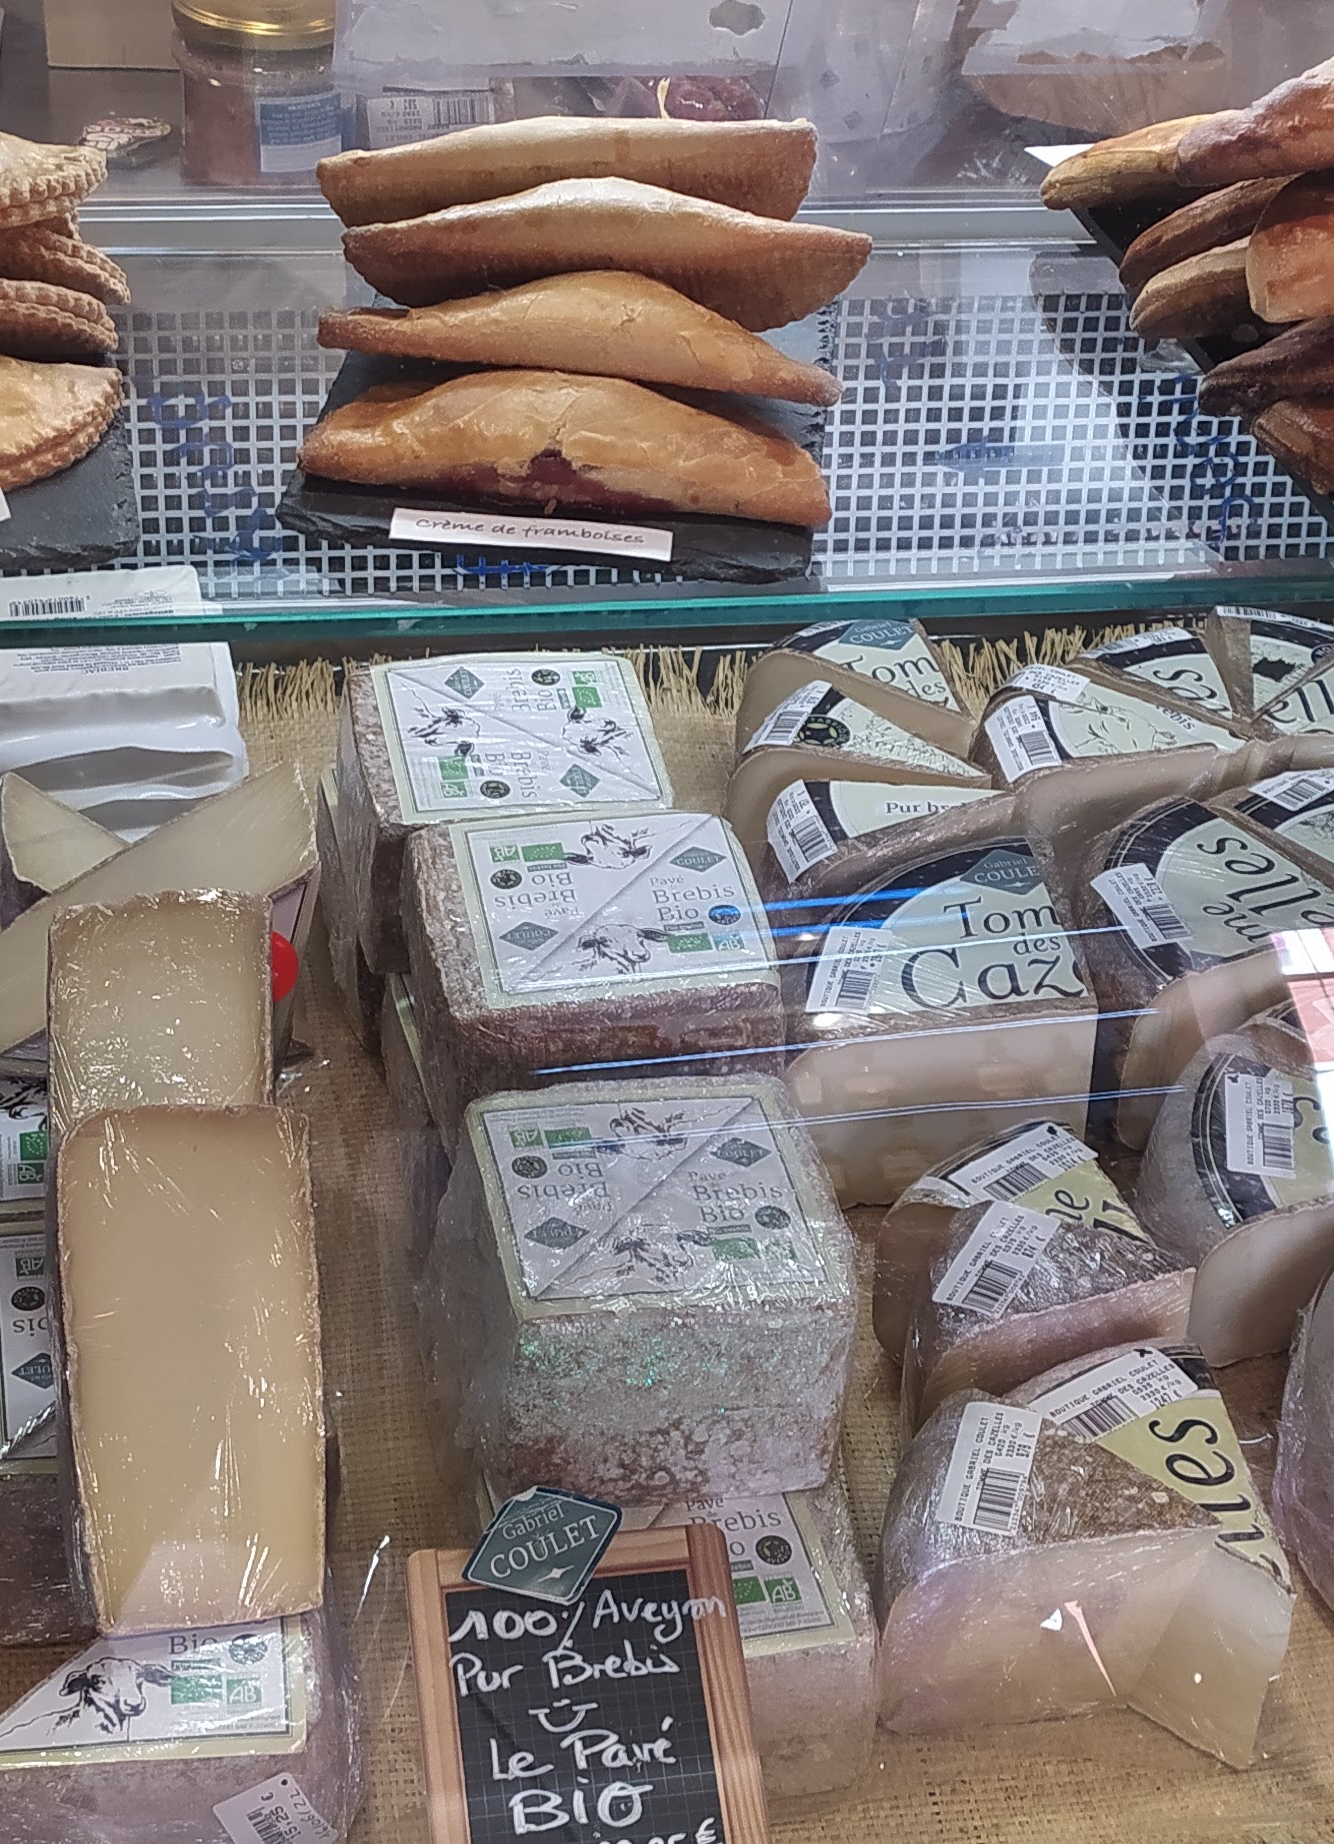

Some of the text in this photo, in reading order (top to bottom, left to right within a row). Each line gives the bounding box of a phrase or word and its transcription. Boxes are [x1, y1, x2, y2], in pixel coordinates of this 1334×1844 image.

[416, 518, 645, 545] Crème de framboises
[849, 626, 917, 645] COULET
[885, 801, 920, 815] Pur
[530, 871, 574, 886] Bio
[649, 874, 685, 887] Pavé
[494, 887, 578, 909] Brebis
[652, 884, 735, 905] Brebis
[657, 904, 700, 923] Bio
[1012, 932, 1061, 956] des
[557, 1162, 604, 1178] Bio
[692, 1181, 784, 1202] Brebis
[699, 1204, 746, 1224] Bio
[1049, 1358, 1159, 1419] BOUTIQUE GABRIEL COULET
[983, 1411, 1004, 1464] DES CAZELLES
[954, 1415, 989, 1522] BOUTIQUE GABRIEL COULET
[502, 1502, 567, 1541] Gabriel
[489, 1514, 601, 1580] COULET
[592, 1589, 727, 1644] Aveyron
[167, 1634, 218, 1657] Bio
[449, 1639, 681, 1697] Pur Brebis
[489, 1716, 677, 1781] Le Pavé
